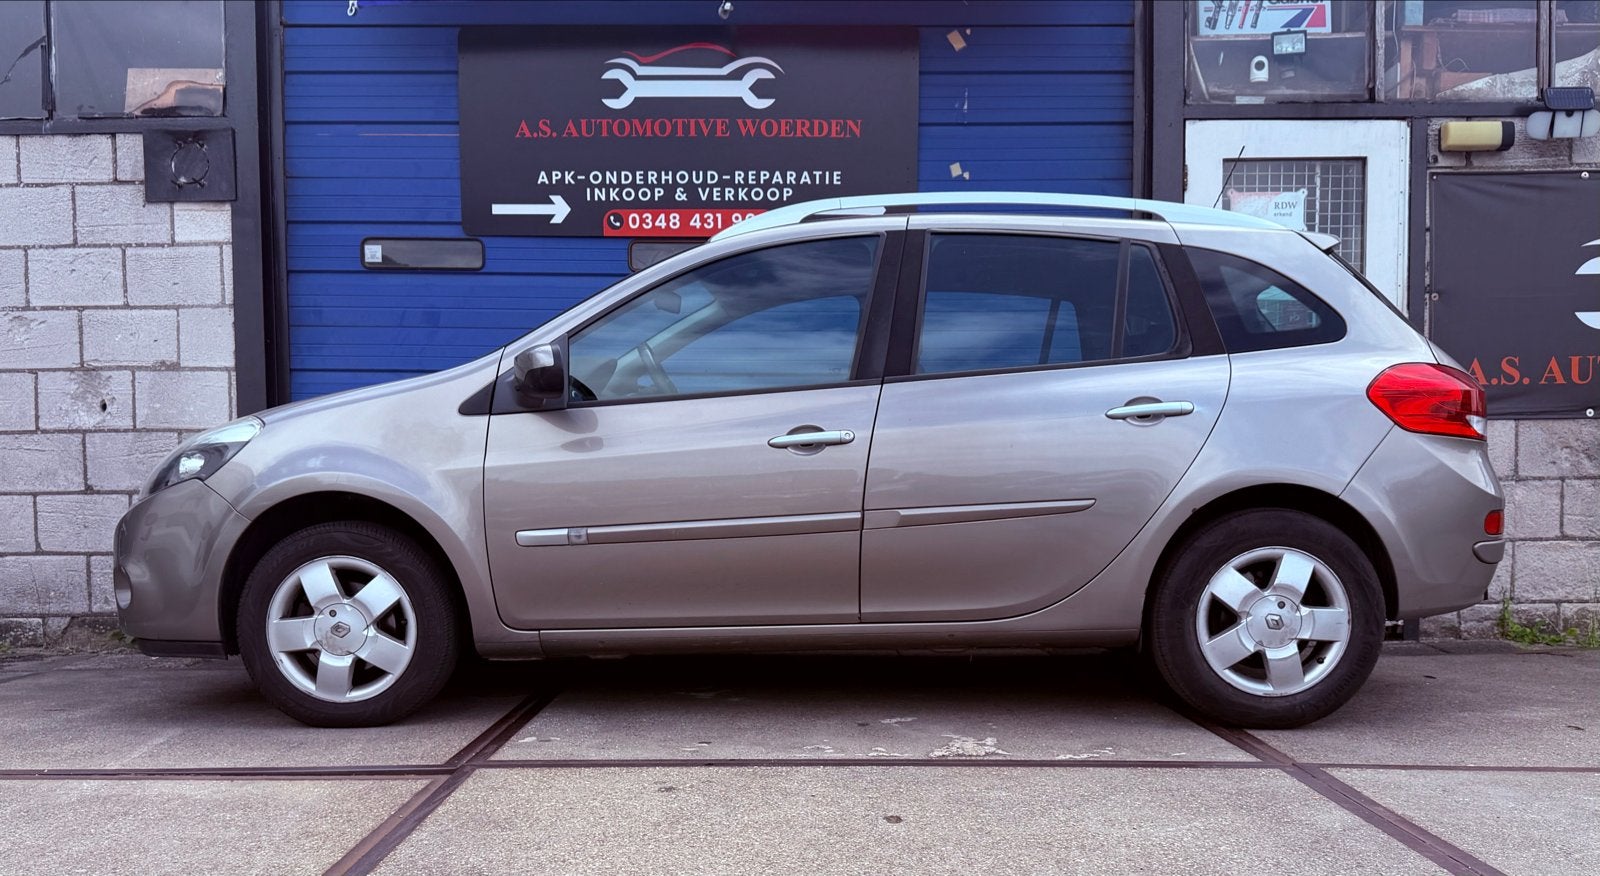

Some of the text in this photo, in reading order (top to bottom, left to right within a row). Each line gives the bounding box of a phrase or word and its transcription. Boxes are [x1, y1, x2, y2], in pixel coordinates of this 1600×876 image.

[515, 118, 863, 138] A.S. AUTOMOTIVE WOERDEN
[537, 170, 842, 185] APK-ONDERHOUD-REPARATIE
[586, 187, 793, 201] INKOOP & VERKOOP
[1274, 201, 1297, 210] RDW
[628, 213, 681, 230] 0348
[689, 213, 722, 230] 431
[1467, 355, 1600, 386] A.S. AU
